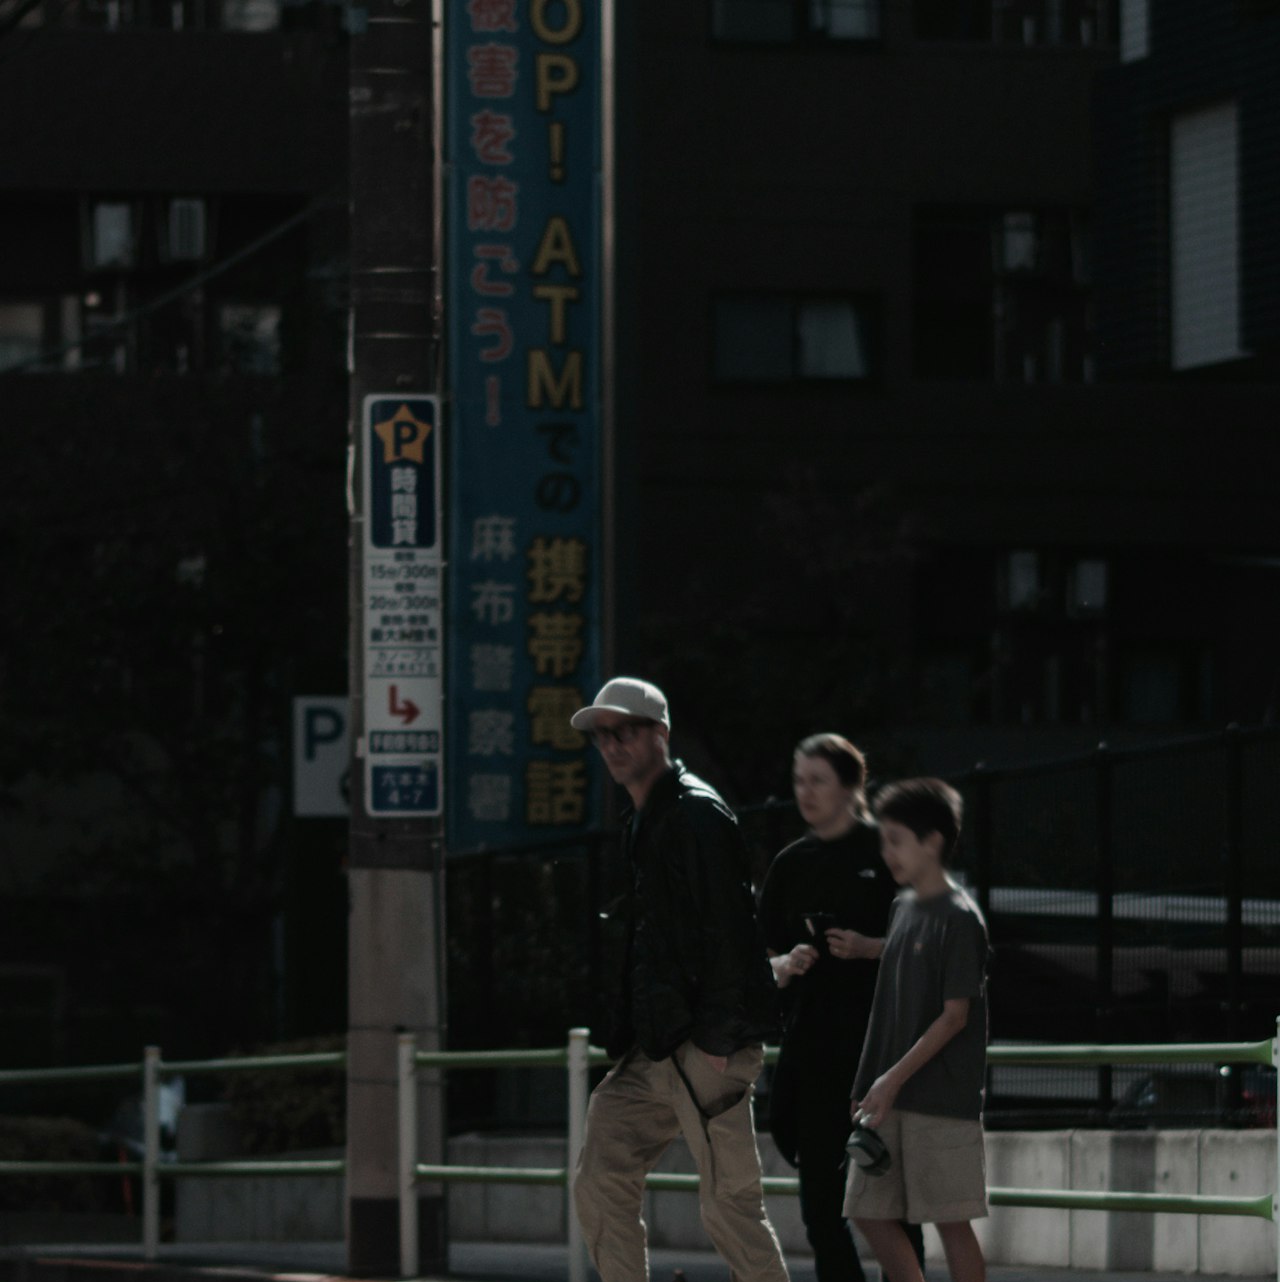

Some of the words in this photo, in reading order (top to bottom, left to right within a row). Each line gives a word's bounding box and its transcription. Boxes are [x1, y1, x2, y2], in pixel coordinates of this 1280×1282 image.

[393, 421, 418, 456] P
[391, 467, 418, 544] 時間貸
[469, 514, 517, 823] 麻布警察署
[305, 707, 344, 761] P
